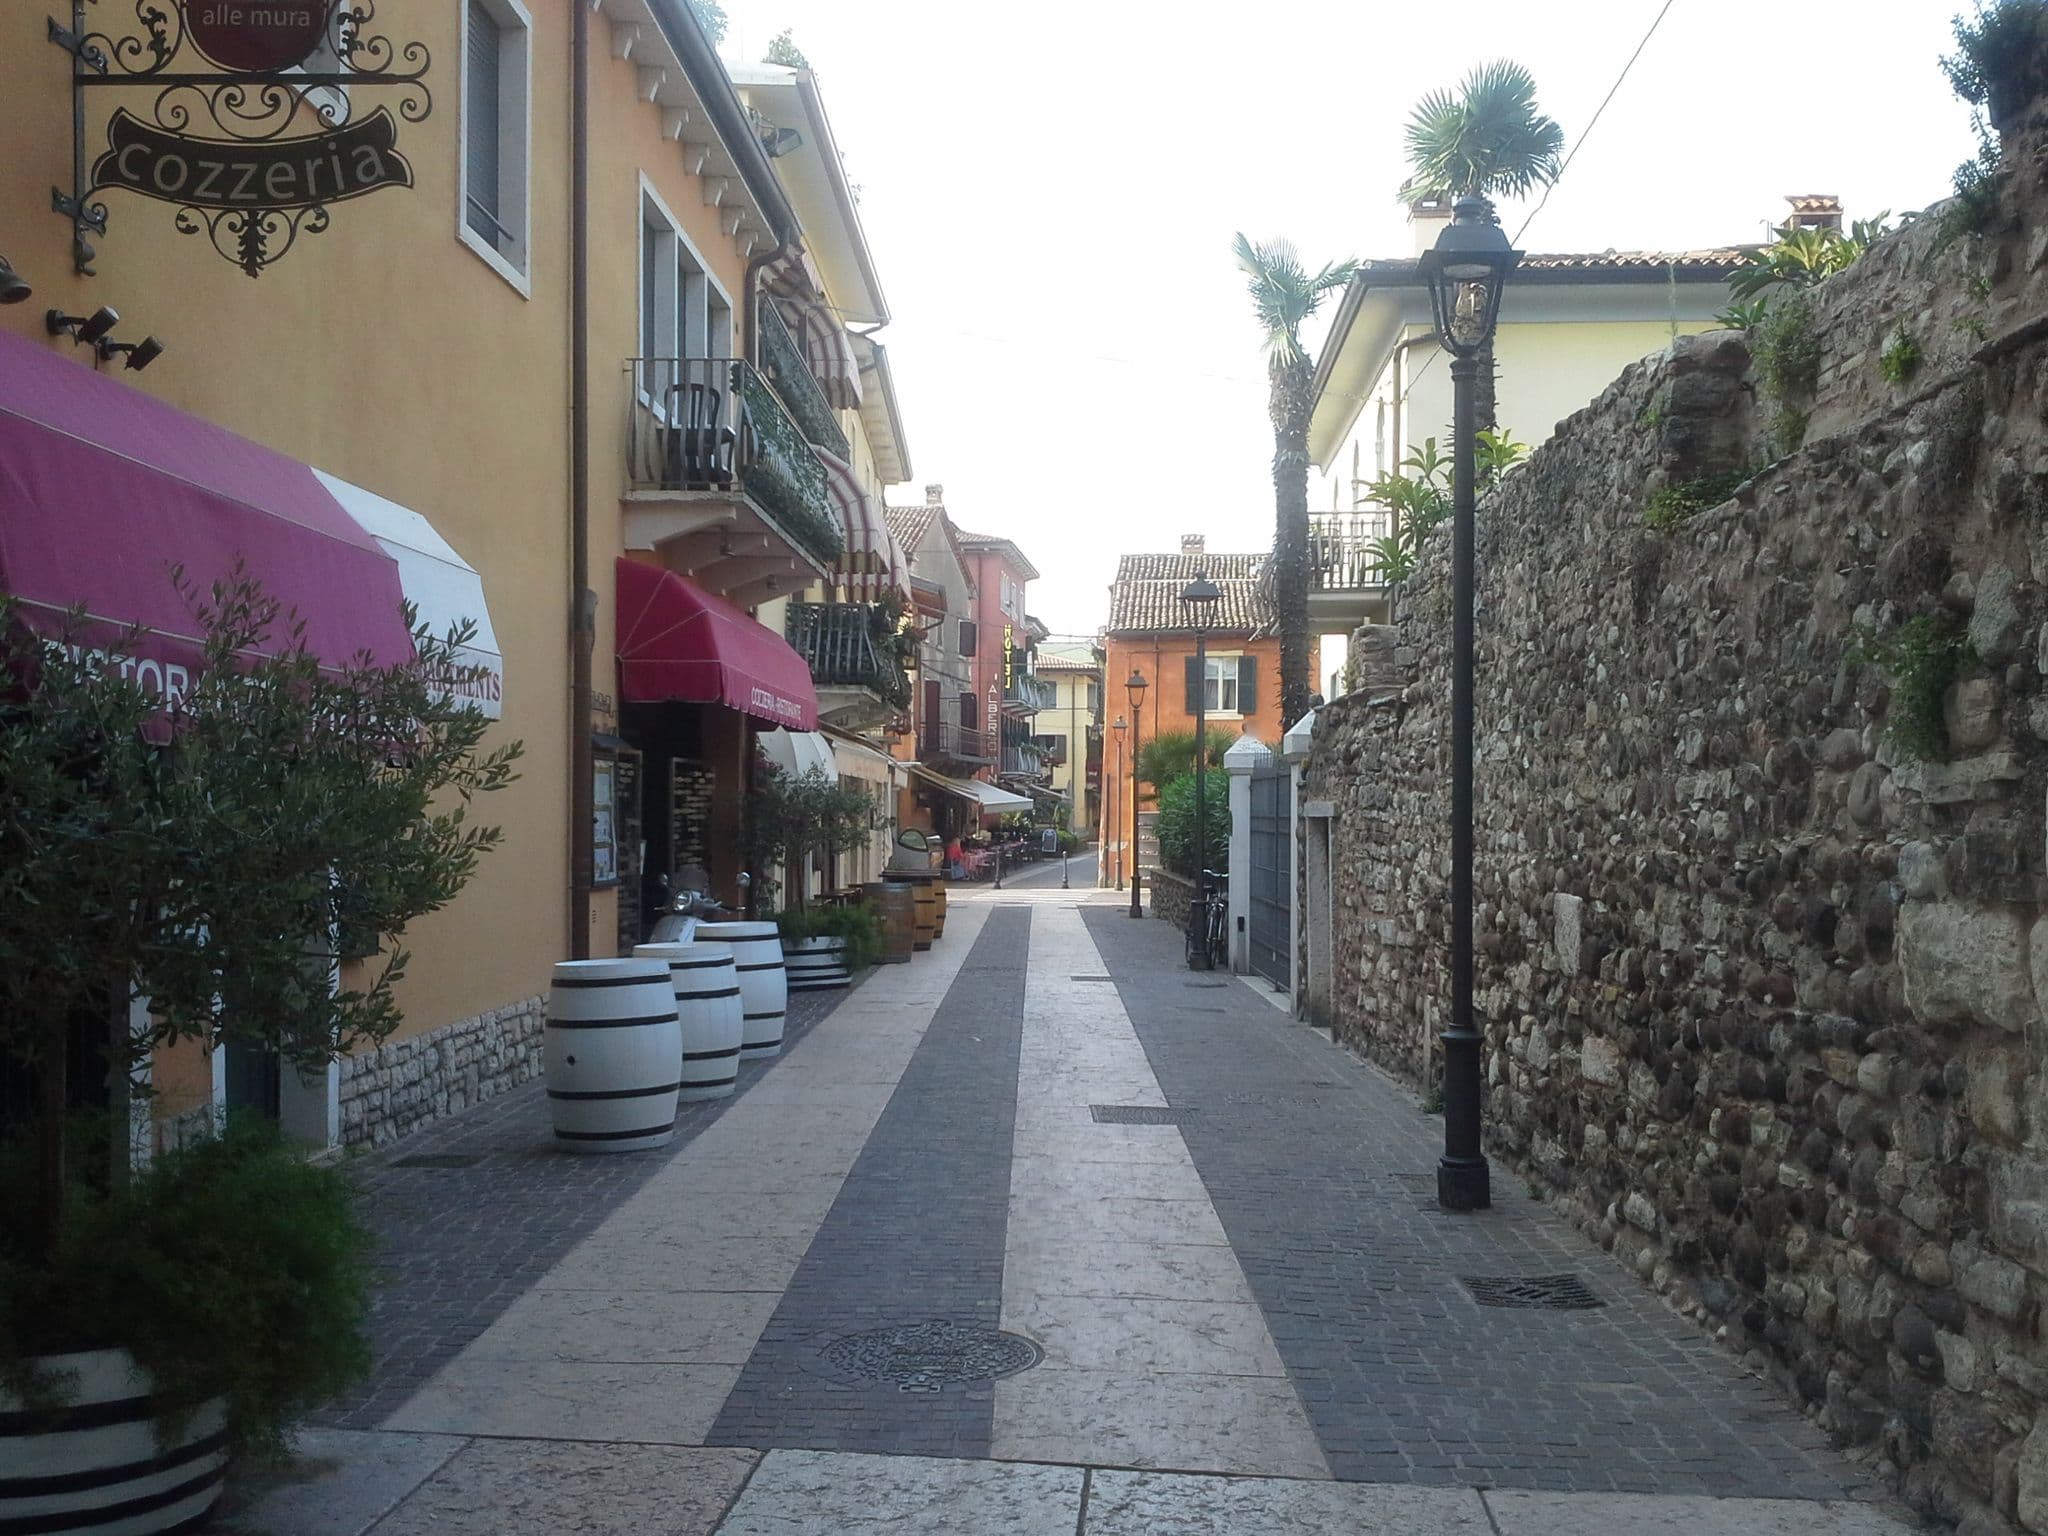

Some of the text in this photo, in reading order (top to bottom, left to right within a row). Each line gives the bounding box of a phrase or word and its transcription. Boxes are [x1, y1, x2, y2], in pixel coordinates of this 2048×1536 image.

[202, 4, 310, 27] alle mura
[118, 141, 386, 200] cozzeria
